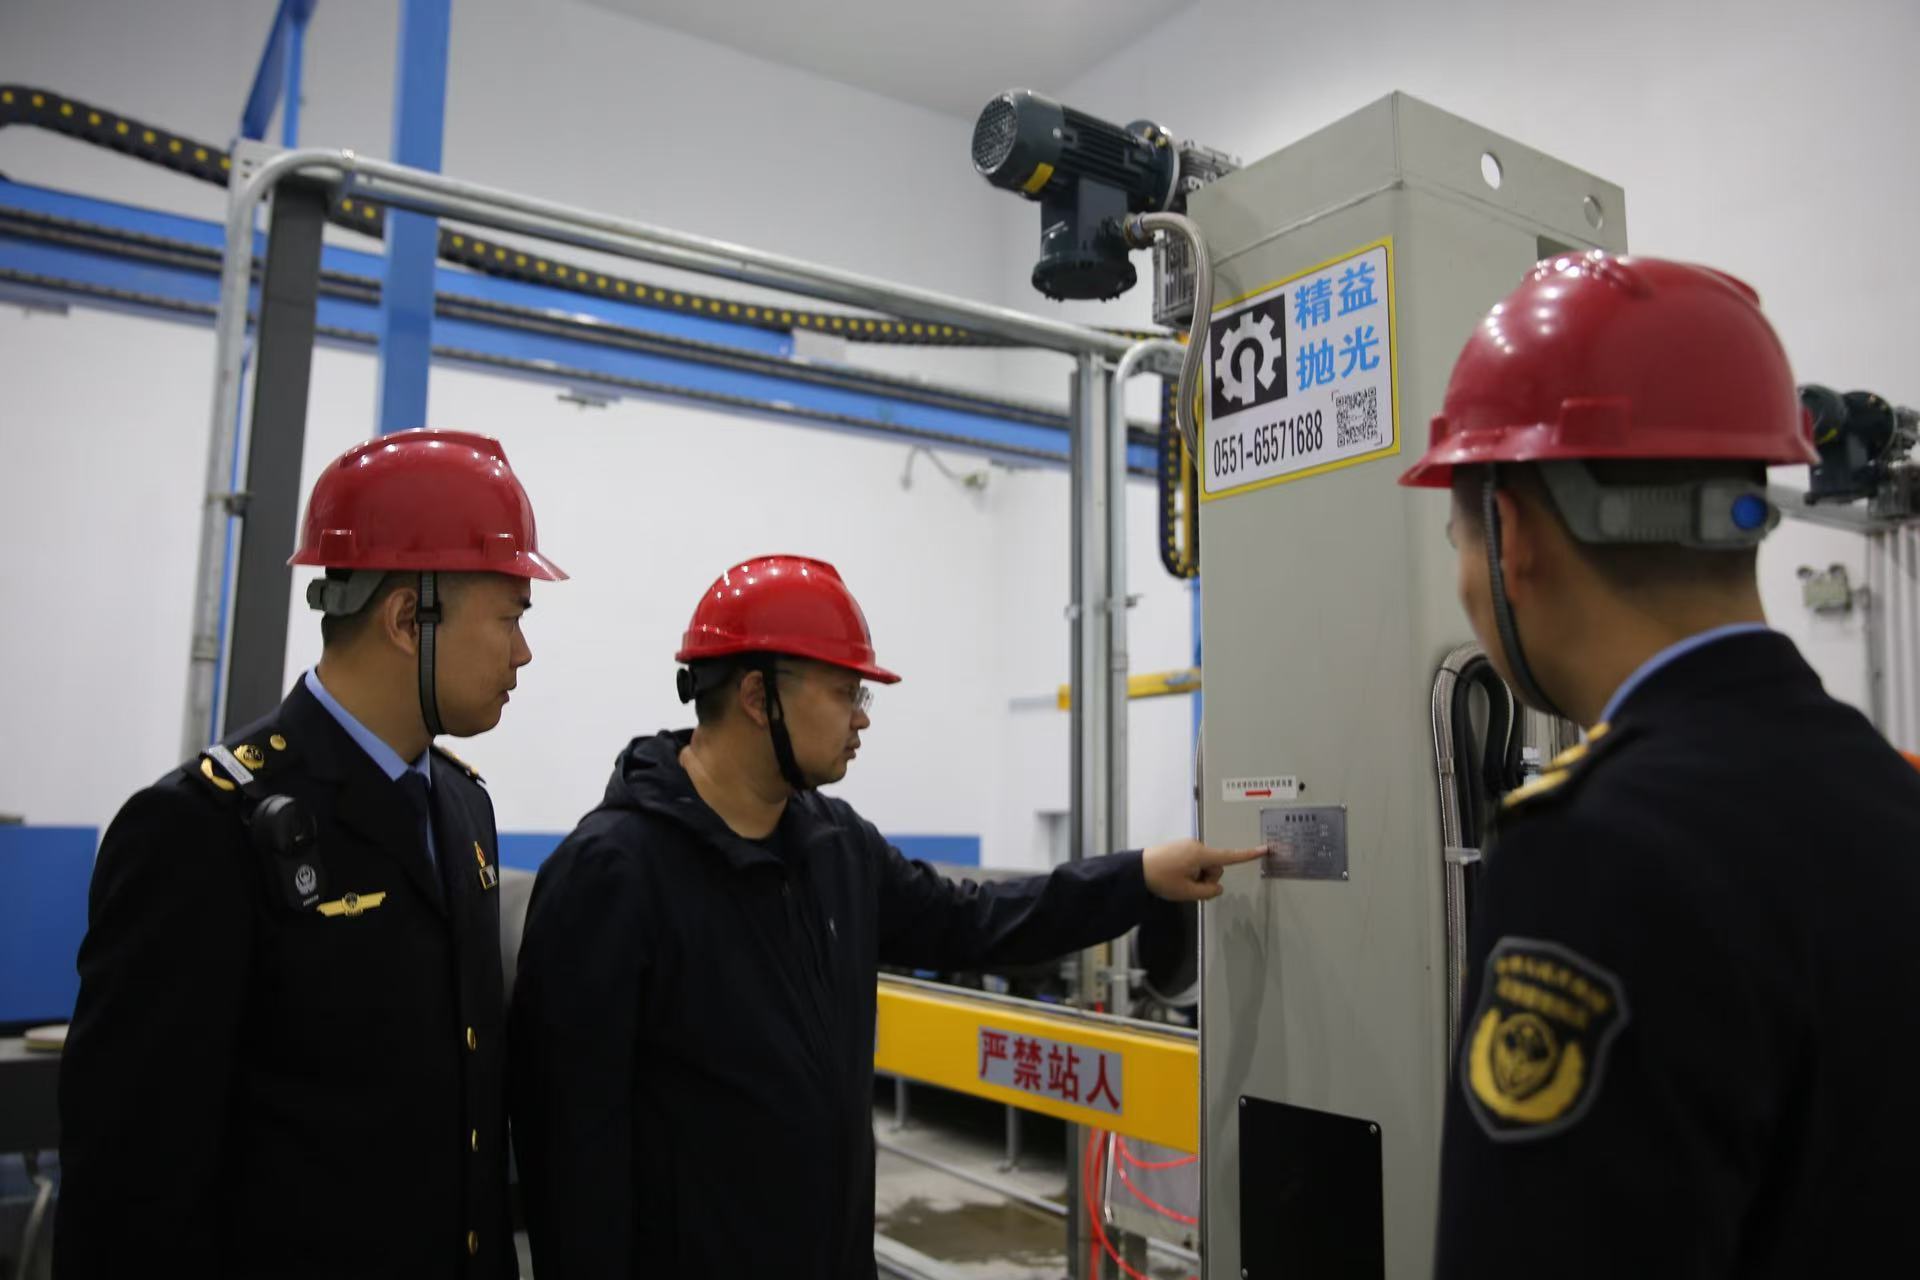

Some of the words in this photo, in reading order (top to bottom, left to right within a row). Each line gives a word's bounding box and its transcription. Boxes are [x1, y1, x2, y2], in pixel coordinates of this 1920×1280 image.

[1294, 262, 1378, 330] 精益
[1296, 326, 1380, 391] 抛光
[1214, 409, 1323, 477] 0551-65571688
[979, 1031, 1120, 1110] 严禁站人
